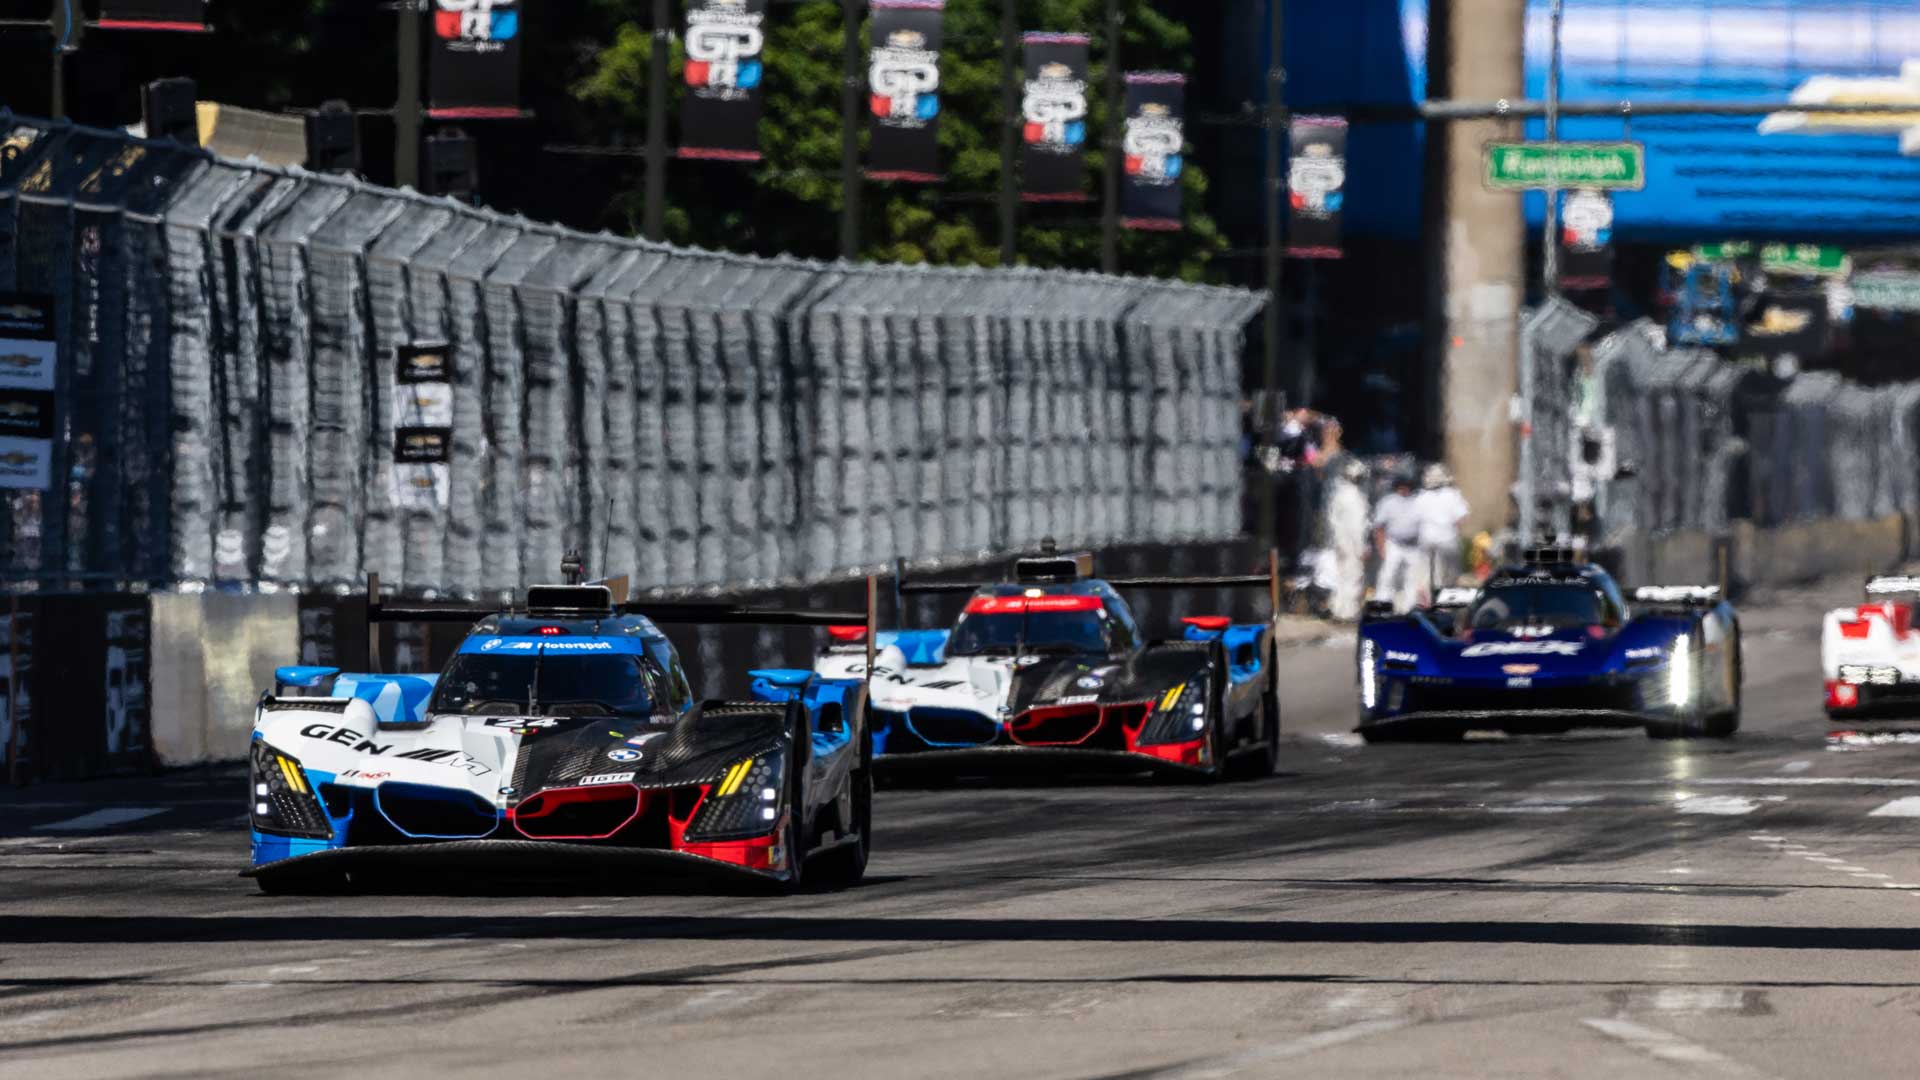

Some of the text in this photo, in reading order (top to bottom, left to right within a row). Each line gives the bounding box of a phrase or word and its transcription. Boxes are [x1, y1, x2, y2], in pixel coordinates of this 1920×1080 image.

[685, 24, 763, 62] GP
[537, 641, 612, 650] Motorsport
[494, 718, 558, 728] 24
[300, 724, 394, 755] GEN
